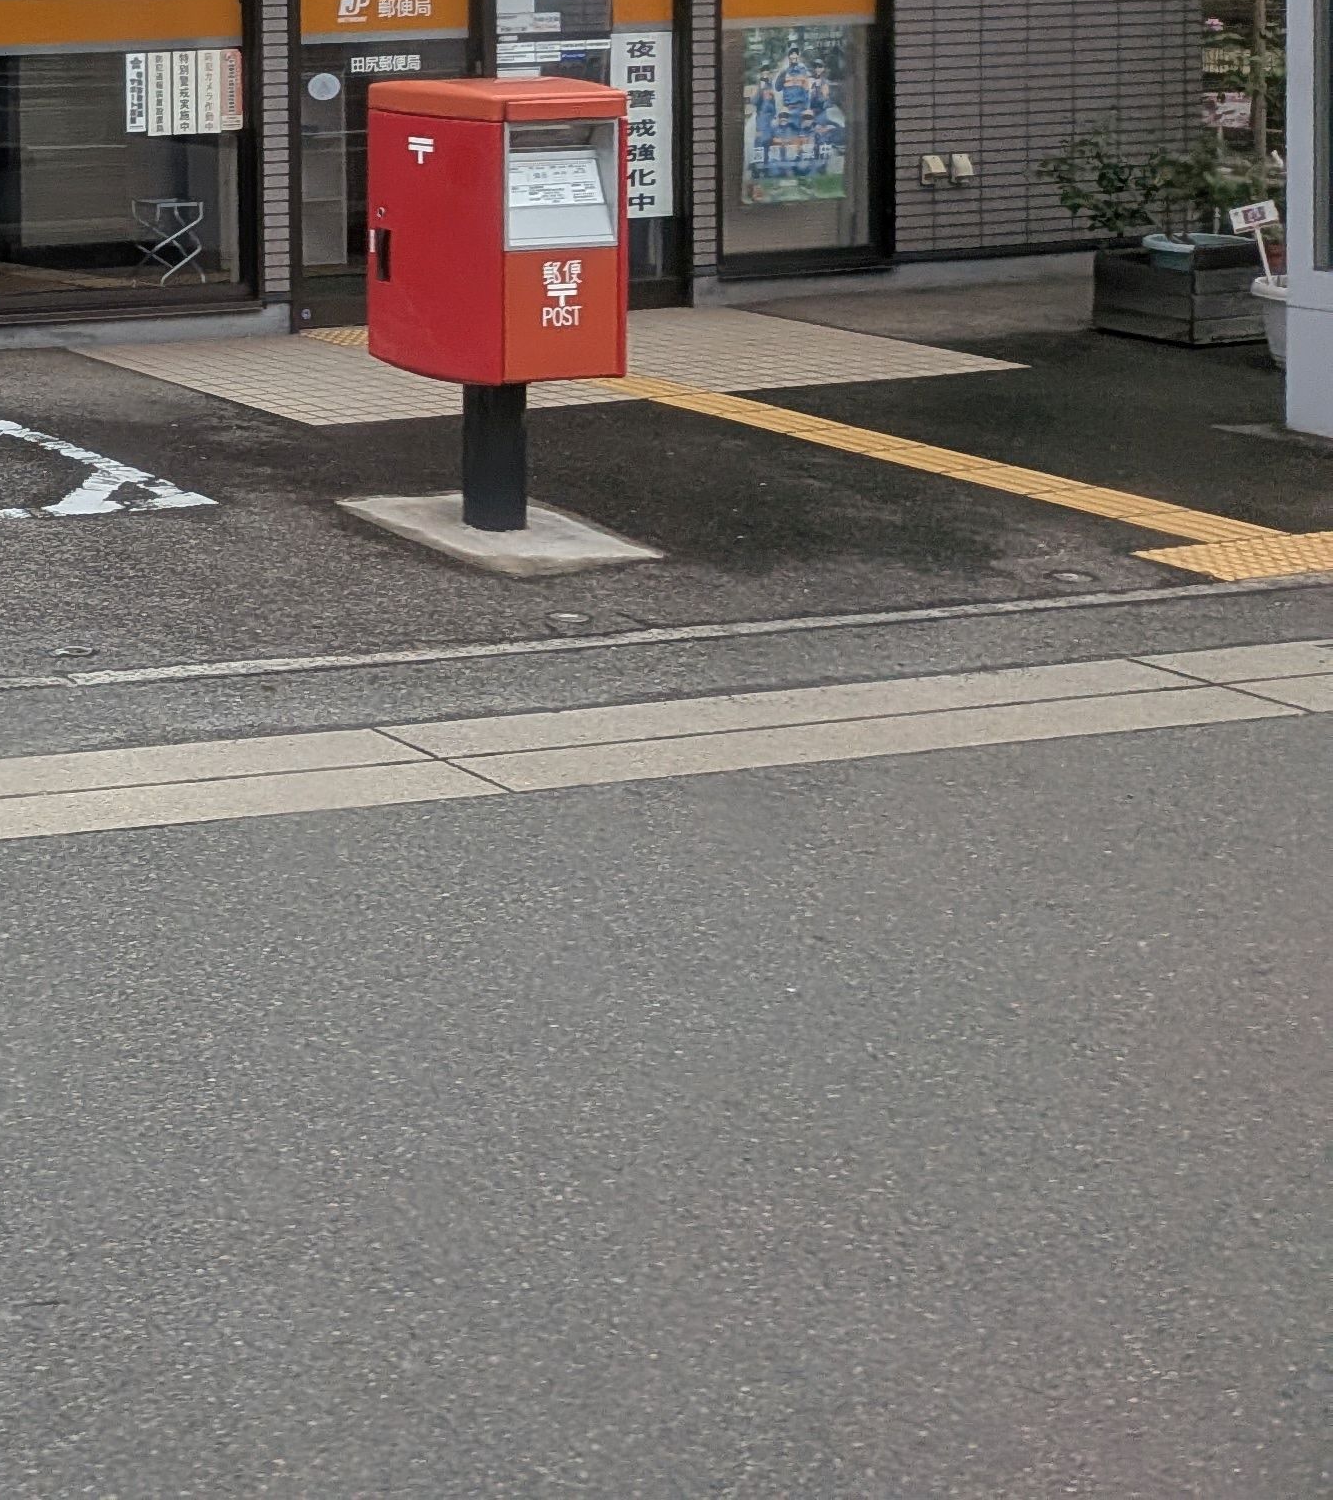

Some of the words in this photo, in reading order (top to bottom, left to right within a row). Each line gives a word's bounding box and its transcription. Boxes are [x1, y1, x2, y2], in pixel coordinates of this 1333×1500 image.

[350, 54, 422, 73] 田尻郵便局
[626, 40, 656, 211] 夜間警戒強化中
[542, 260, 583, 285] 郵便
[542, 306, 583, 327] POST
